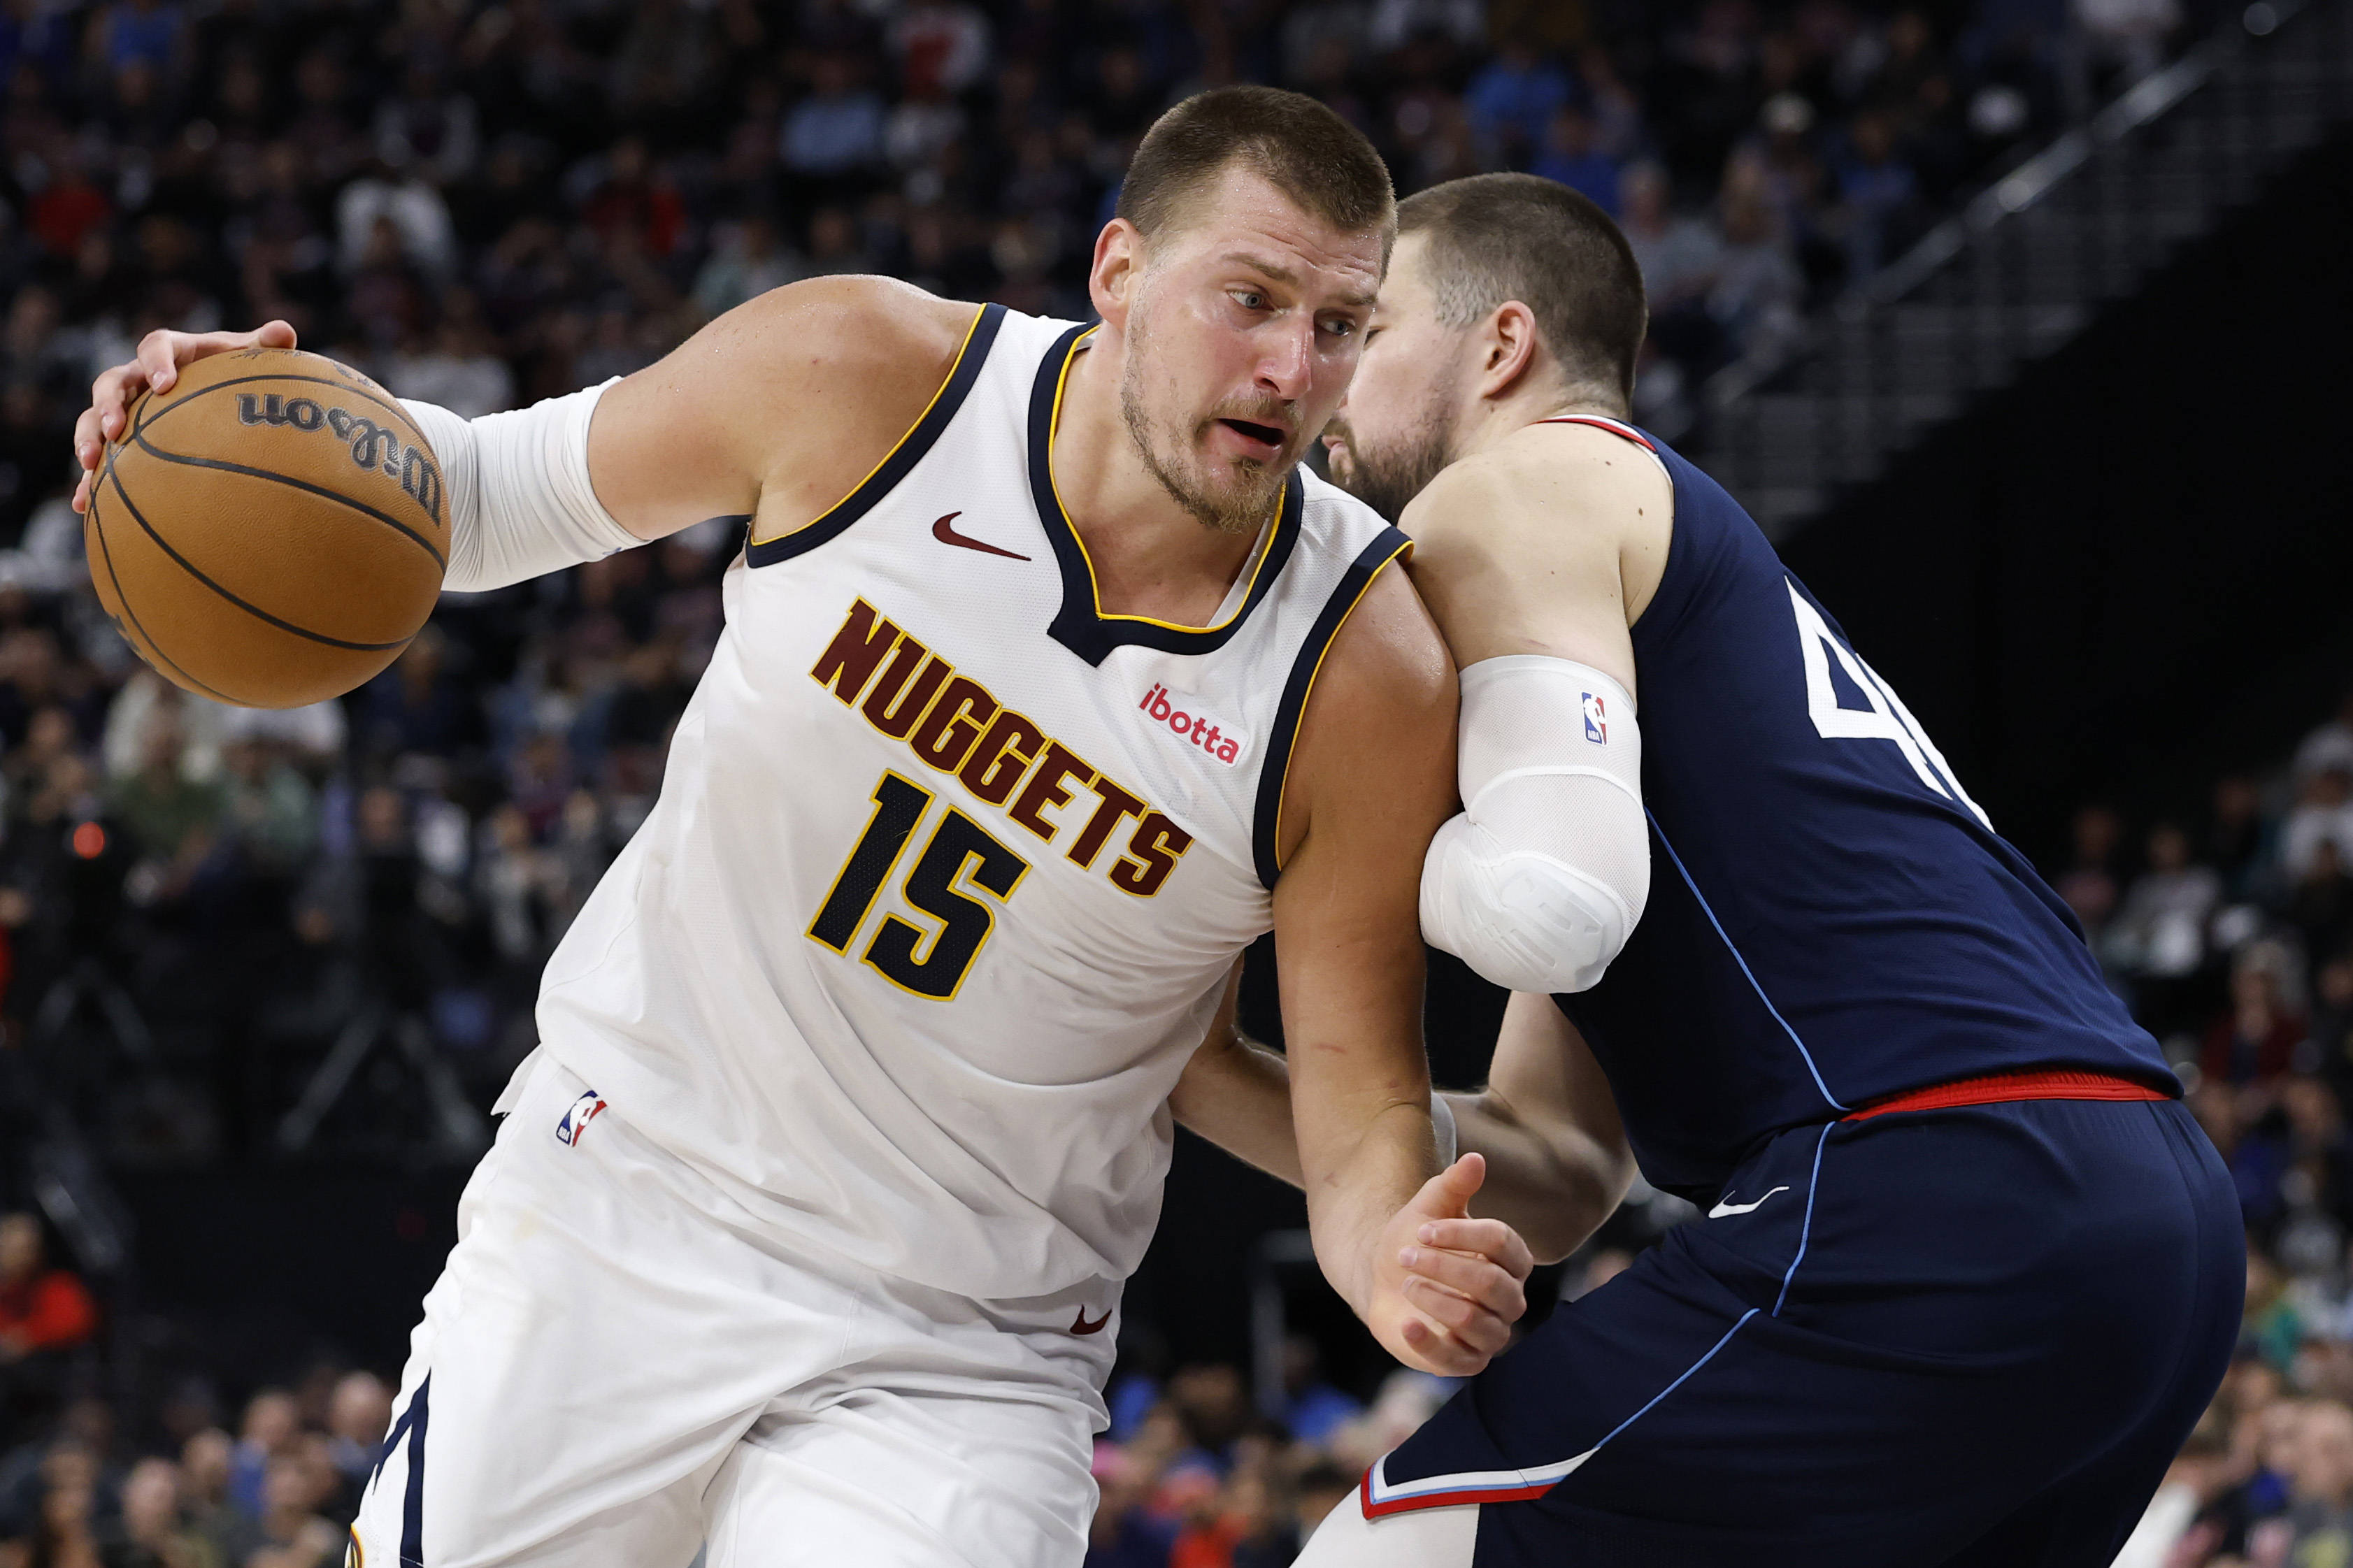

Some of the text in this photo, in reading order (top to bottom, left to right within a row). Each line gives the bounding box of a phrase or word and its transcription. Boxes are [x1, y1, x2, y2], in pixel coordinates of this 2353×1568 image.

[236, 394, 441, 527] Wilson
[808, 595, 1194, 898] NUGGETS
[1139, 682, 1239, 763] ibotta
[804, 768, 1033, 1001] 15
